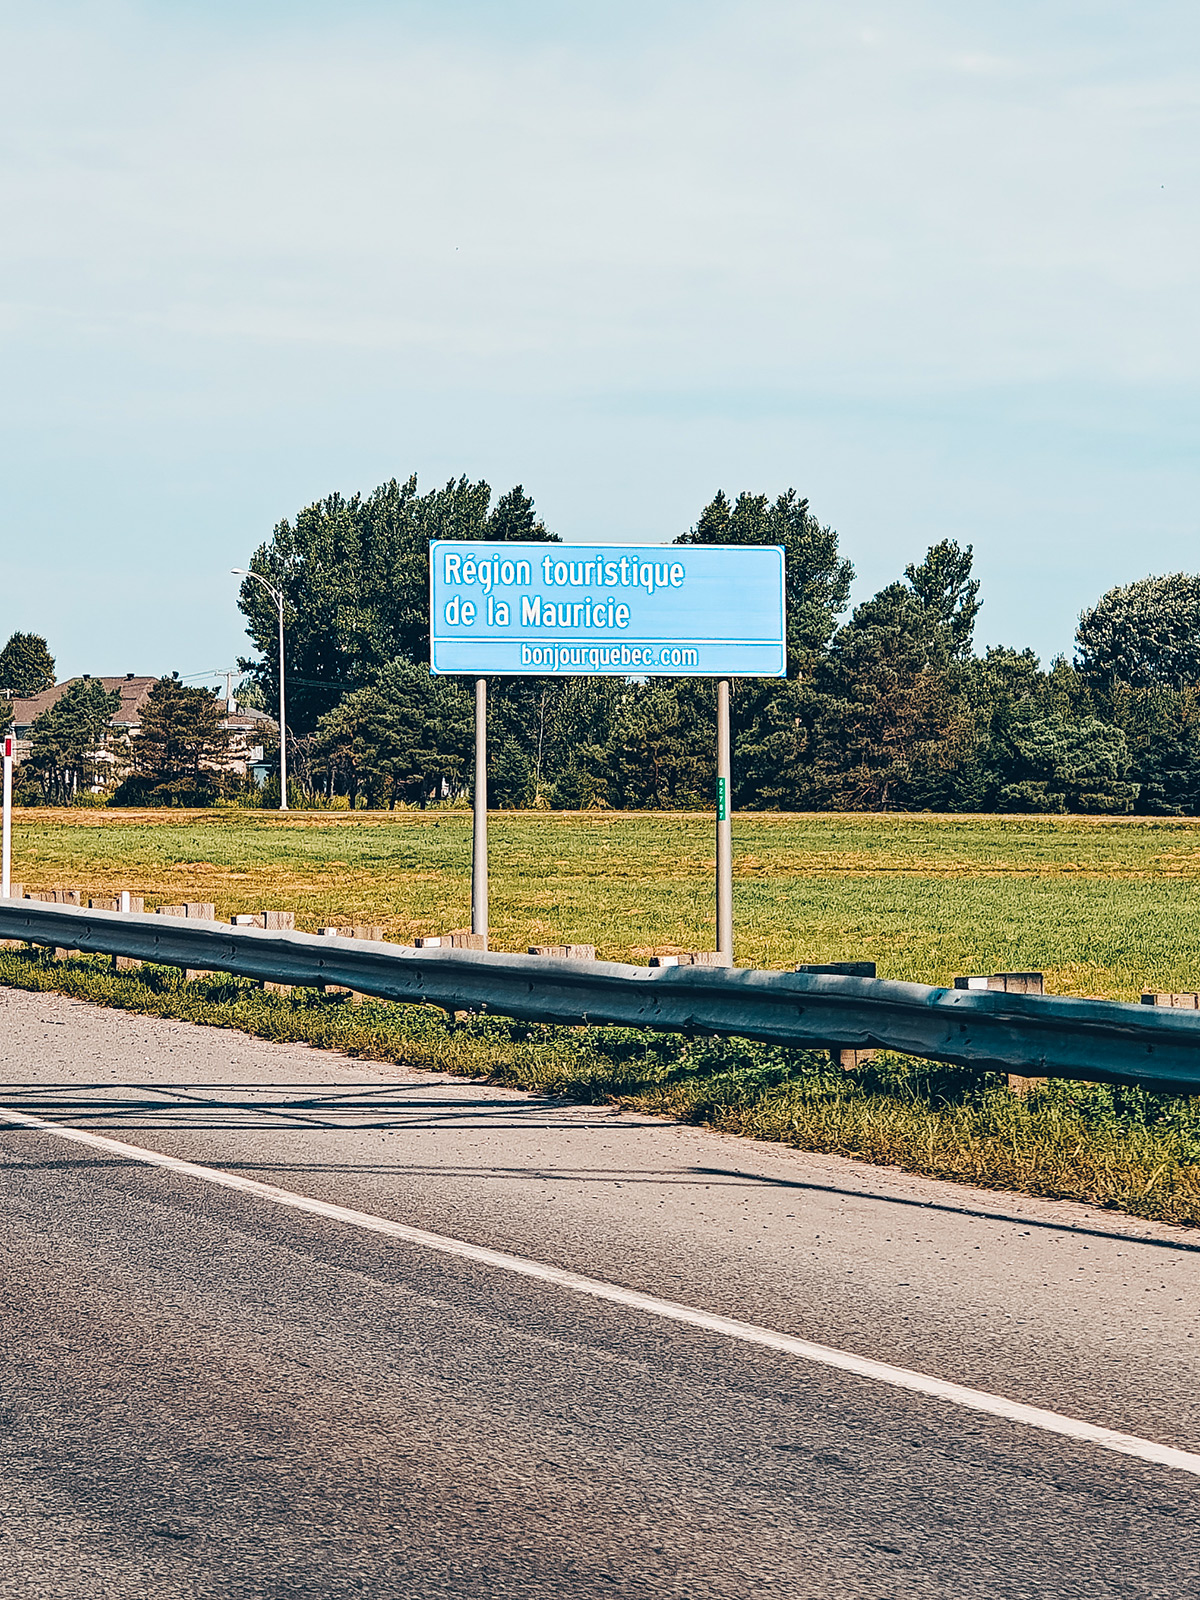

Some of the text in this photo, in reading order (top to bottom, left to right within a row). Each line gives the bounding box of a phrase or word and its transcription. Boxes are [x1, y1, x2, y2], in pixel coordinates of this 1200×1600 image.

[445, 553, 684, 594] Région touristique
[445, 596, 630, 627] de la Mauricie
[522, 644, 698, 670] bonjourquebec.com
